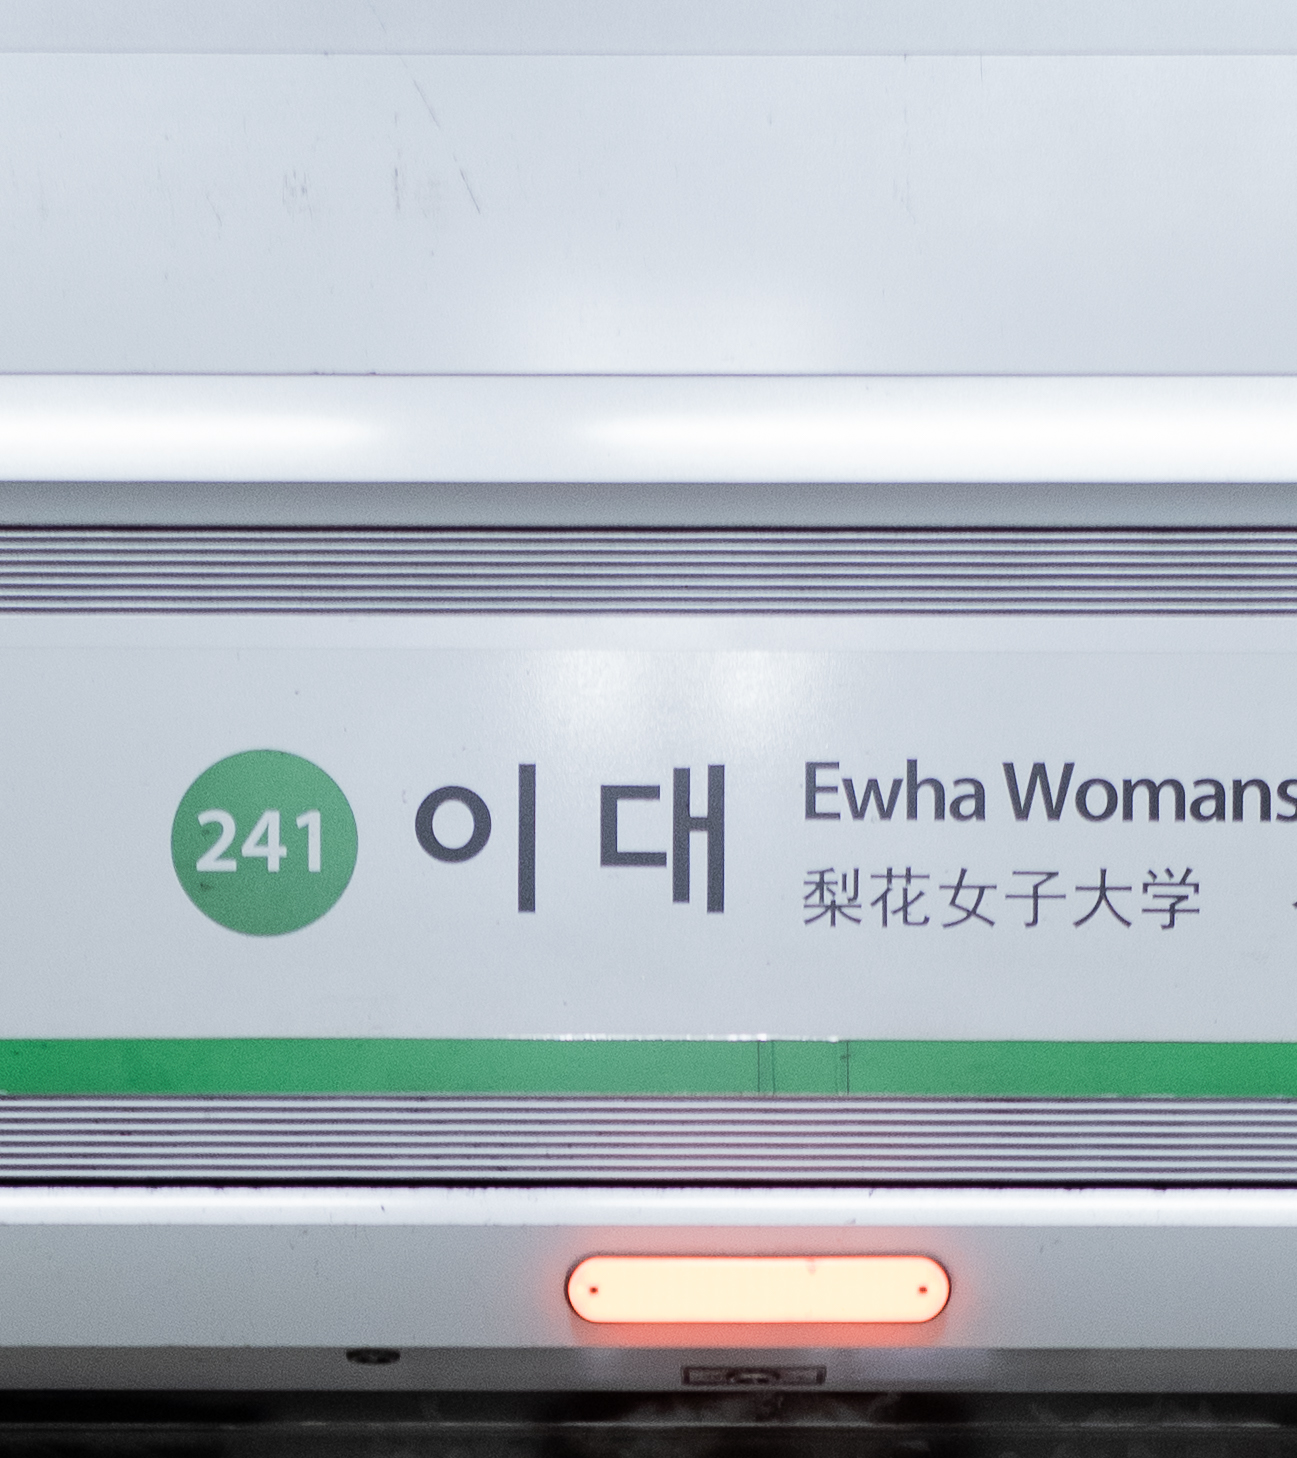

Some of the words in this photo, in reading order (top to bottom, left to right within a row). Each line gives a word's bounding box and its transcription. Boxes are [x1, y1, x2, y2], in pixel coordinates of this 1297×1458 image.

[803, 758, 986, 824] Ewha
[195, 809, 324, 874] 241
[802, 867, 1202, 930] 梨花女子大学
